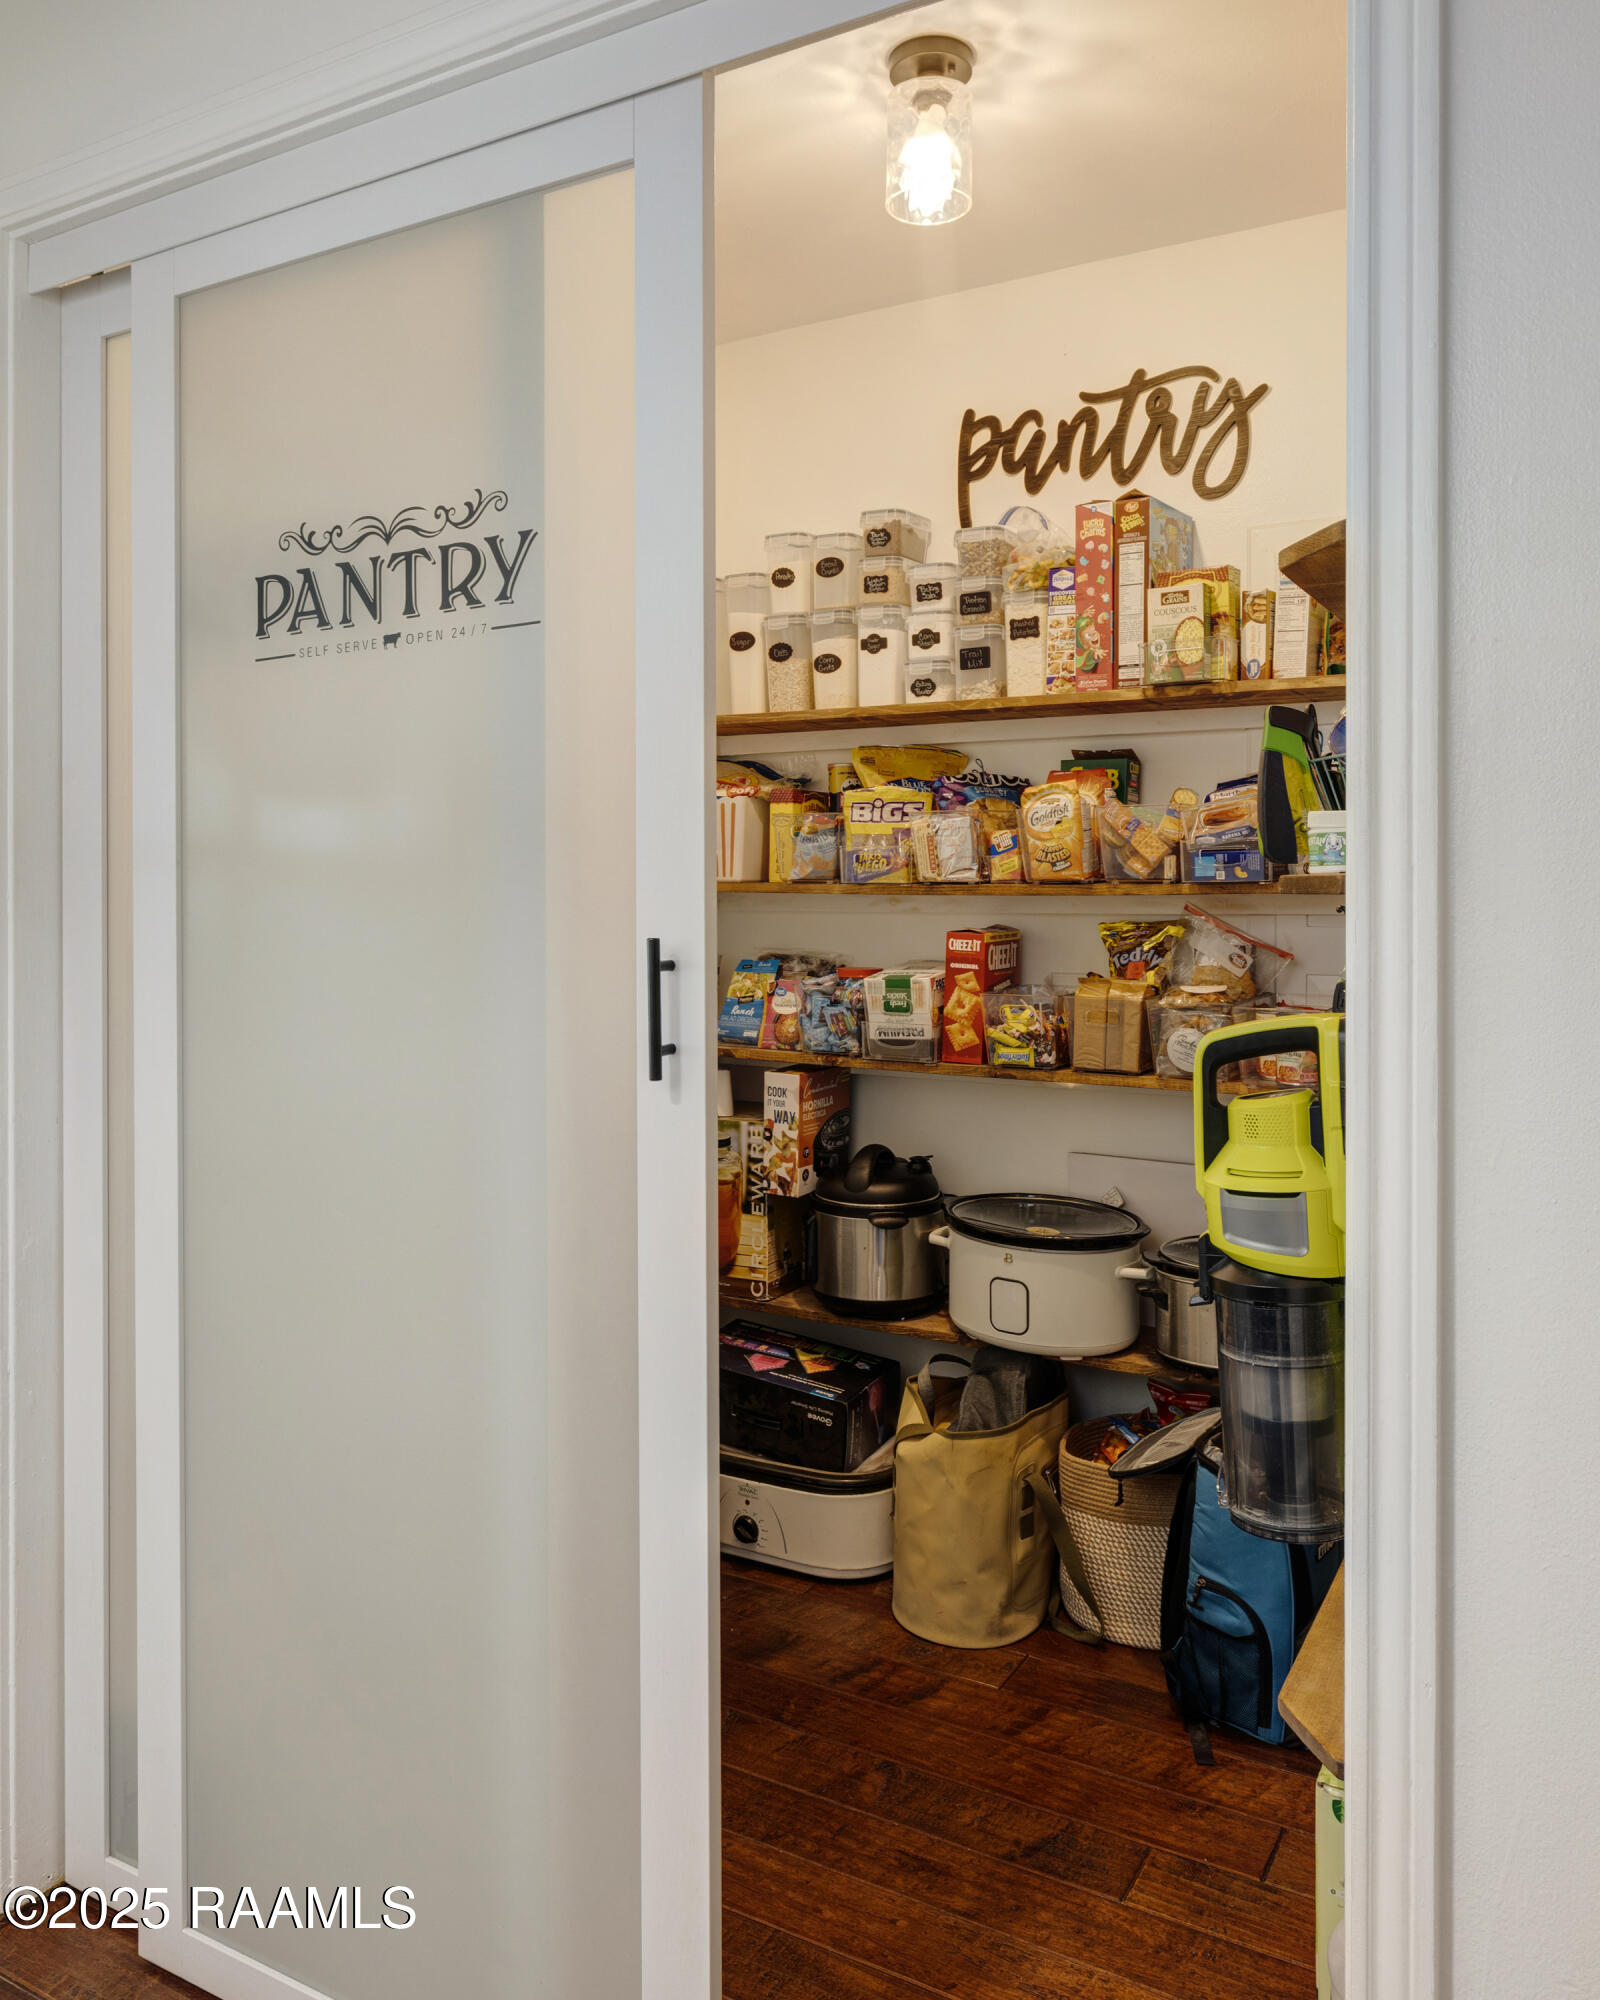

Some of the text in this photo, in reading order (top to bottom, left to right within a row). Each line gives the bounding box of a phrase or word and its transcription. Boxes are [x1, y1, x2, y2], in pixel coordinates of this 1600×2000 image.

[958, 366, 1268, 528] pantry
[255, 529, 538, 639] PANTRY
[1153, 605, 1198, 616] COUSCOUS
[298, 646, 329, 659] SELF
[336, 638, 378, 654] SERVE
[405, 629, 444, 645] OPEN
[731, 637, 751, 648] Sugar
[818, 656, 834, 664] Corn
[961, 649, 982, 658] Trail
[967, 659, 984, 668] Mix
[901, 779, 925, 789] BLUE
[1030, 802, 1069, 827] Goldfish
[1036, 848, 1072, 863] BLASTED
[730, 1004, 755, 1017] Ranch
[767, 1086, 788, 1098] COOK
[802, 1095, 834, 1112] HORNILLA
[773, 1109, 796, 1125] WAY
[750, 1125, 765, 1298] CIRCLEWARE
[807, 1412, 833, 1427] Govee
